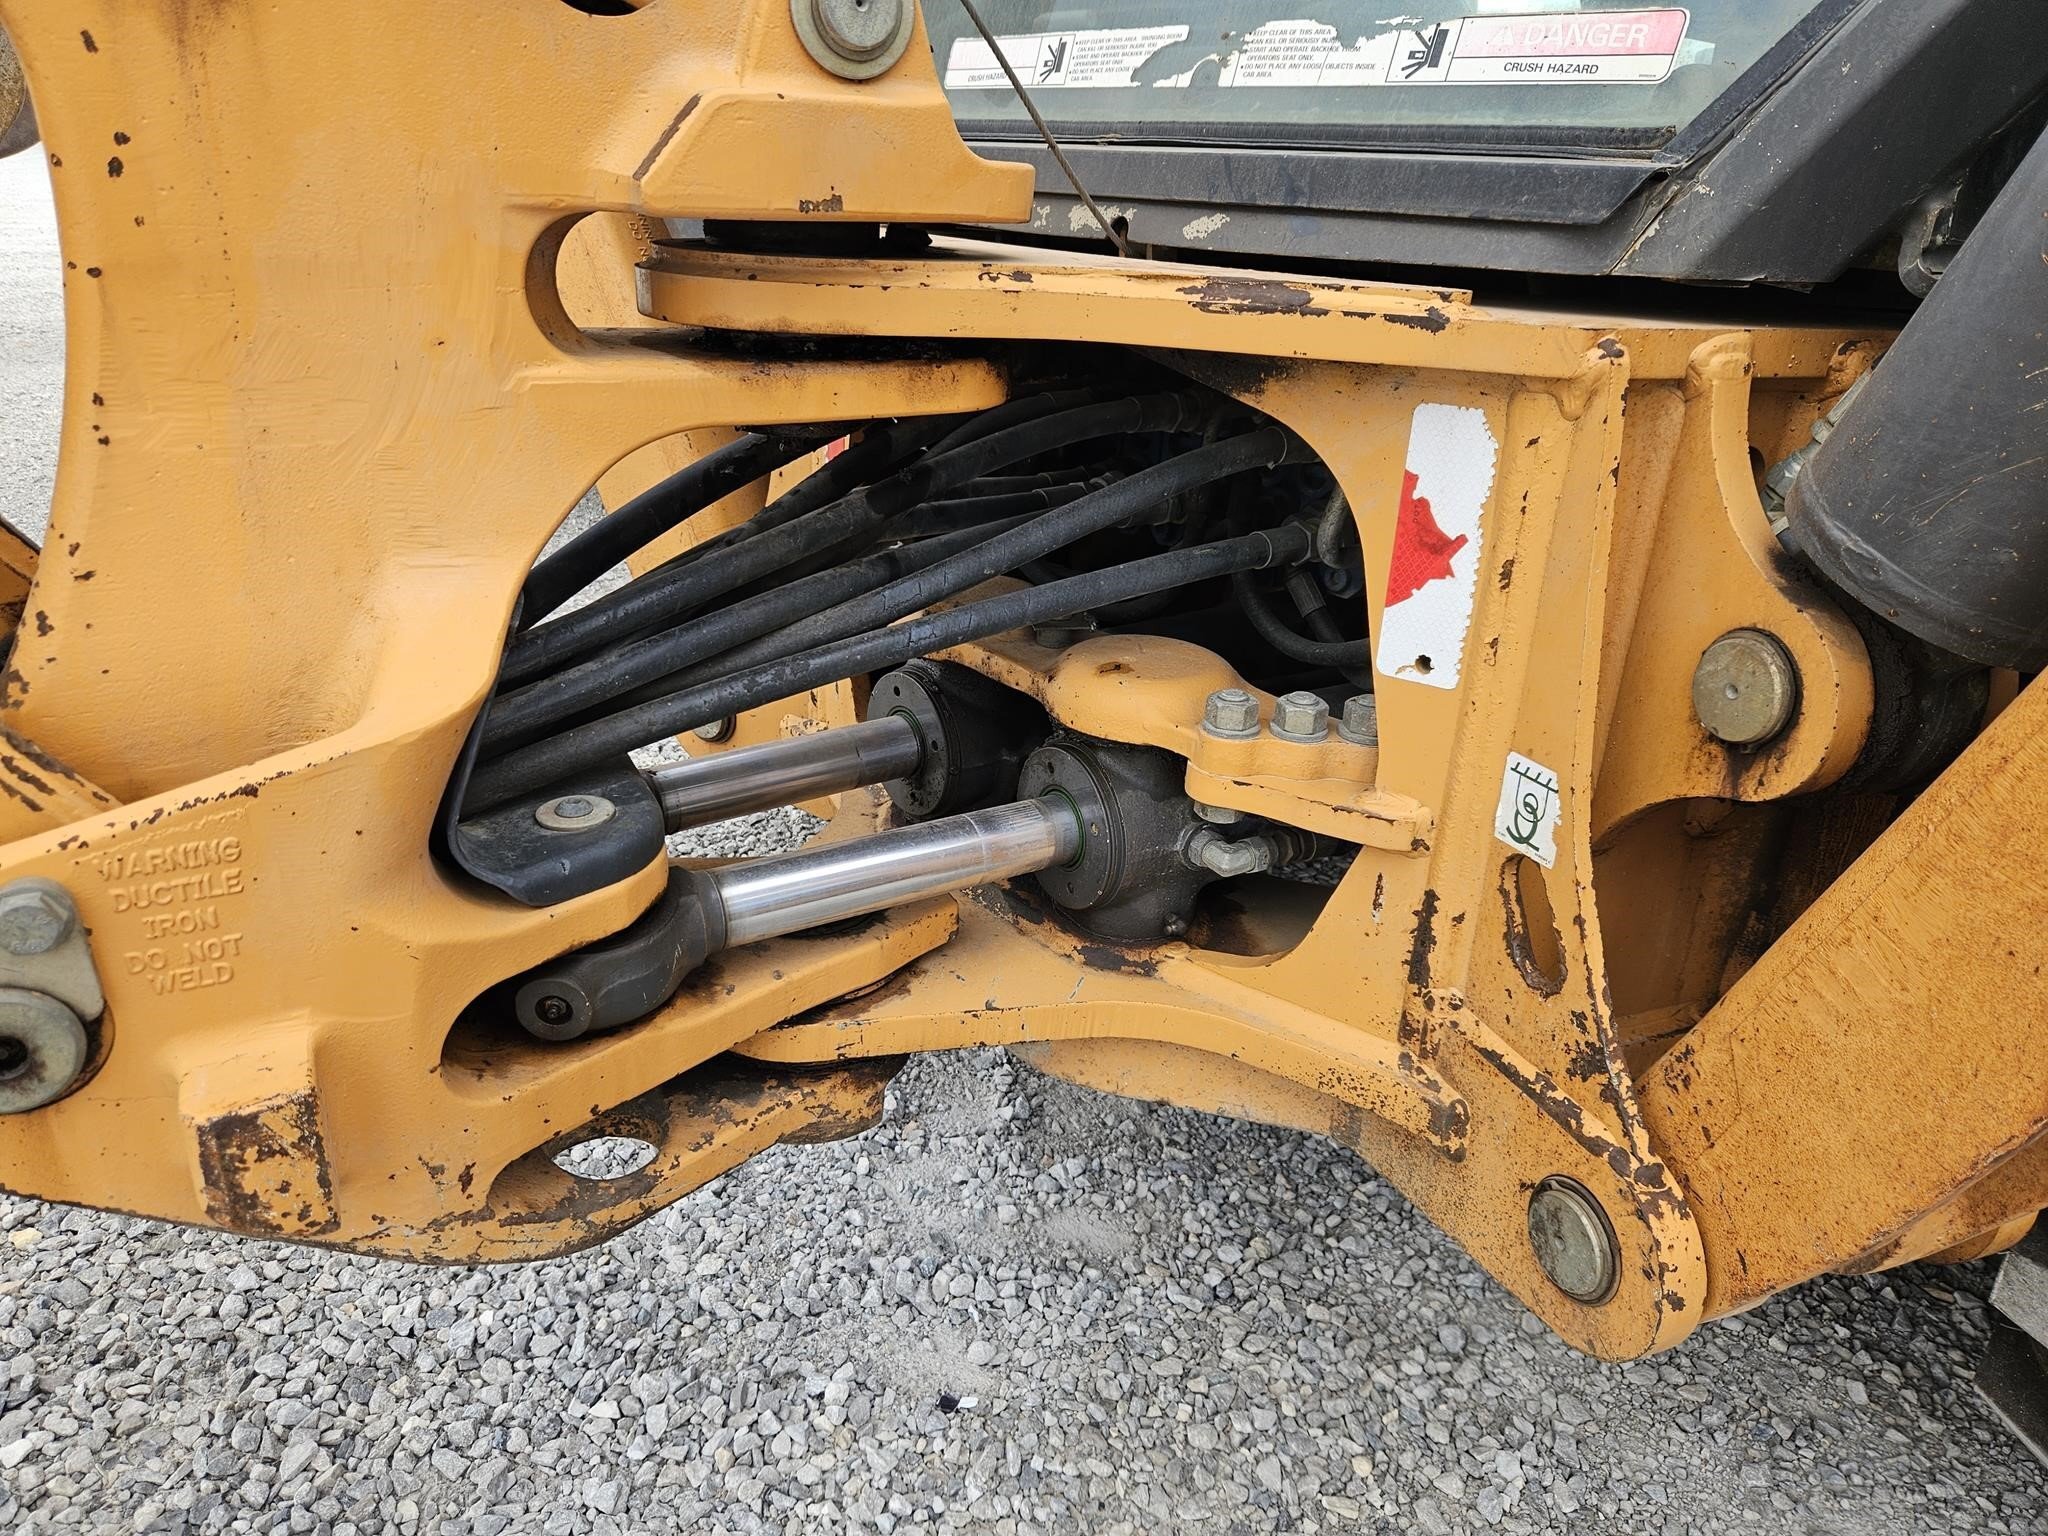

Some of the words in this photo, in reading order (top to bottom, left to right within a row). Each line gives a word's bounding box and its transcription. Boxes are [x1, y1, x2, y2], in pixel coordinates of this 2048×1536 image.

[1523, 22, 1649, 48] DANGER
[1504, 62, 1544, 72] CRUSH
[1546, 63, 1599, 74] HAZARD
[92, 836, 242, 881] WARNING
[109, 867, 245, 913] DUCTILE
[142, 906, 219, 939] IRON
[124, 947, 167, 975] DO
[183, 932, 243, 965] NOT
[146, 962, 234, 995] WELD
